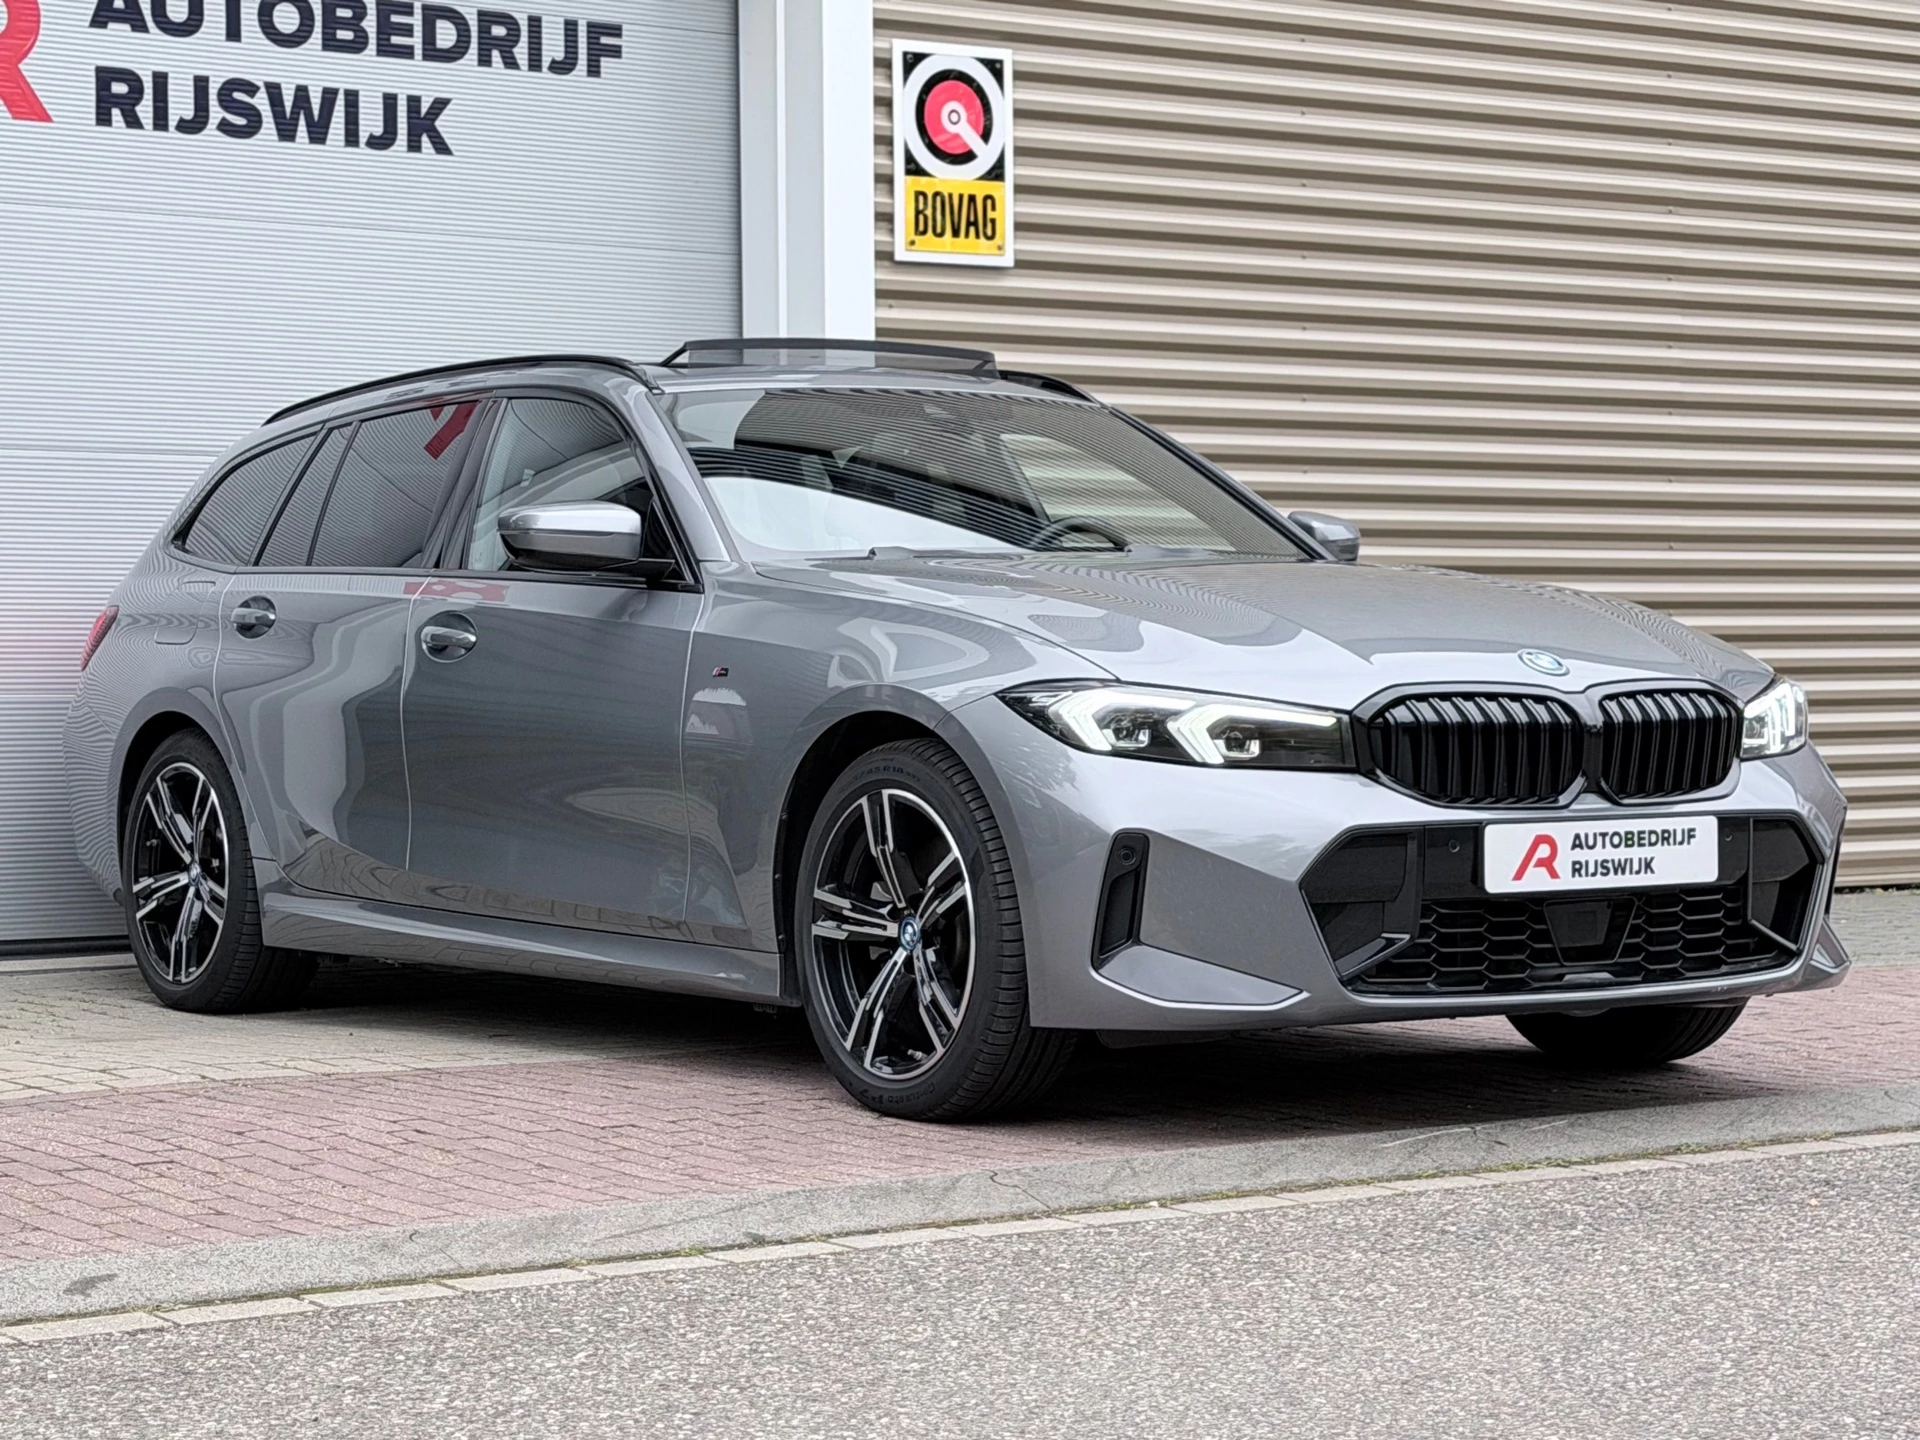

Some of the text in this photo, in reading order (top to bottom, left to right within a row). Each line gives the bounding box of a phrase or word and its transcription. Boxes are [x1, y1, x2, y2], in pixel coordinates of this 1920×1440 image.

[95, 65, 455, 156] RIJSWIJK
[914, 190, 997, 241] BOVAG
[1570, 828, 1696, 851] AUTOBEDRIJF
[1571, 857, 1655, 879] RIJSWIJK
